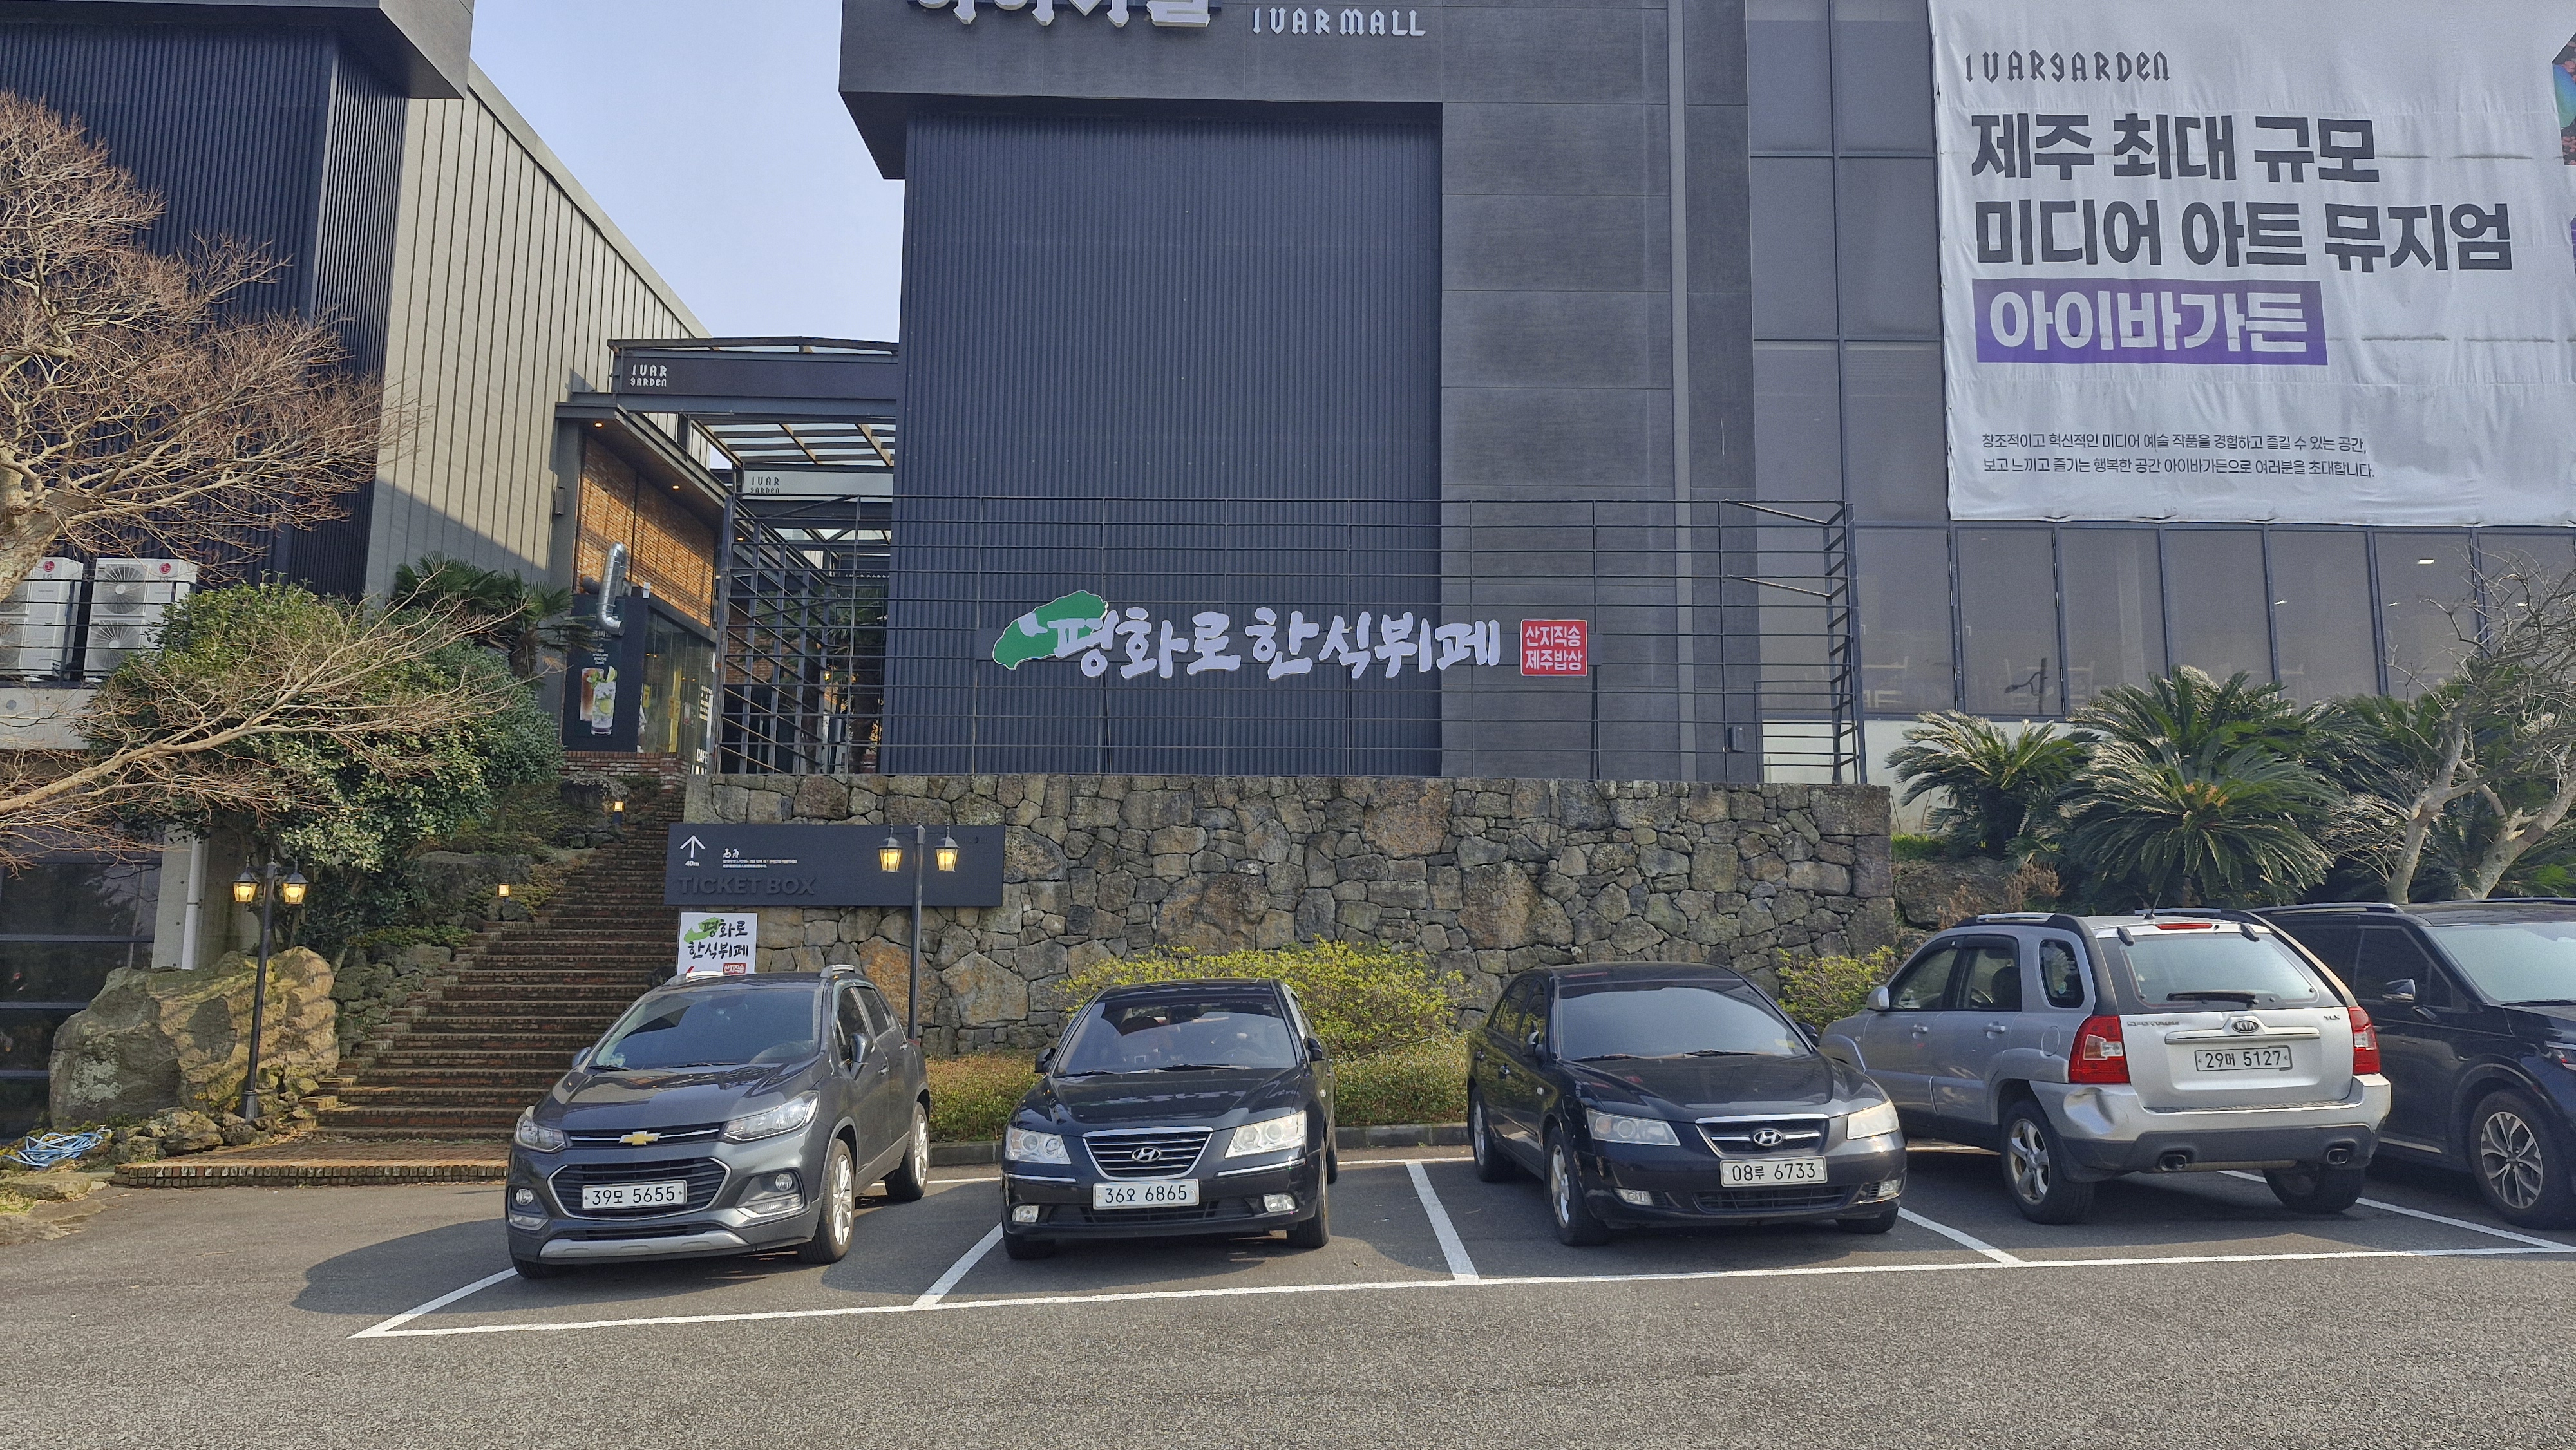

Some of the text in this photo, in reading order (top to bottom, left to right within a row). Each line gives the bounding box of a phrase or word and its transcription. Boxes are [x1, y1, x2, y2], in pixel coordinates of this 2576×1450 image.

[1971, 113, 2380, 183] 제주 최대 규모
[1975, 199, 2512, 273] 미디어 아트 뮤지엄
[1989, 290, 2307, 352] 아이바가든
[632, 364, 667, 377] IVAR
[1982, 433, 2367, 454] 창조적이고 혁신적인 미디어 예술 작품을 경험하고 즐길 수 있는 공간,
[1984, 458, 2375, 477] 보고 느끼고 즐기는 행복한 공간 아이바가든으로 여러분을 초대합니다.
[1047, 607, 1501, 680] 평화로 한식뷔페
[1525, 625, 1581, 647] 산지직송
[1526, 650, 1583, 670] 제주밥상
[679, 877, 817, 895] TICKET BOX
[702, 919, 748, 937] 평화로
[688, 941, 748, 959] 한식뷔페
[723, 965, 744, 974] 산지직송
[2236, 1022, 2256, 1031] KIA
[2205, 1051, 2281, 1068] 29머 5127
[1732, 1162, 1815, 1181] 08루 6733
[592, 1186, 675, 1205] 39모 5655
[1105, 1185, 1187, 1203] 36오 6865
